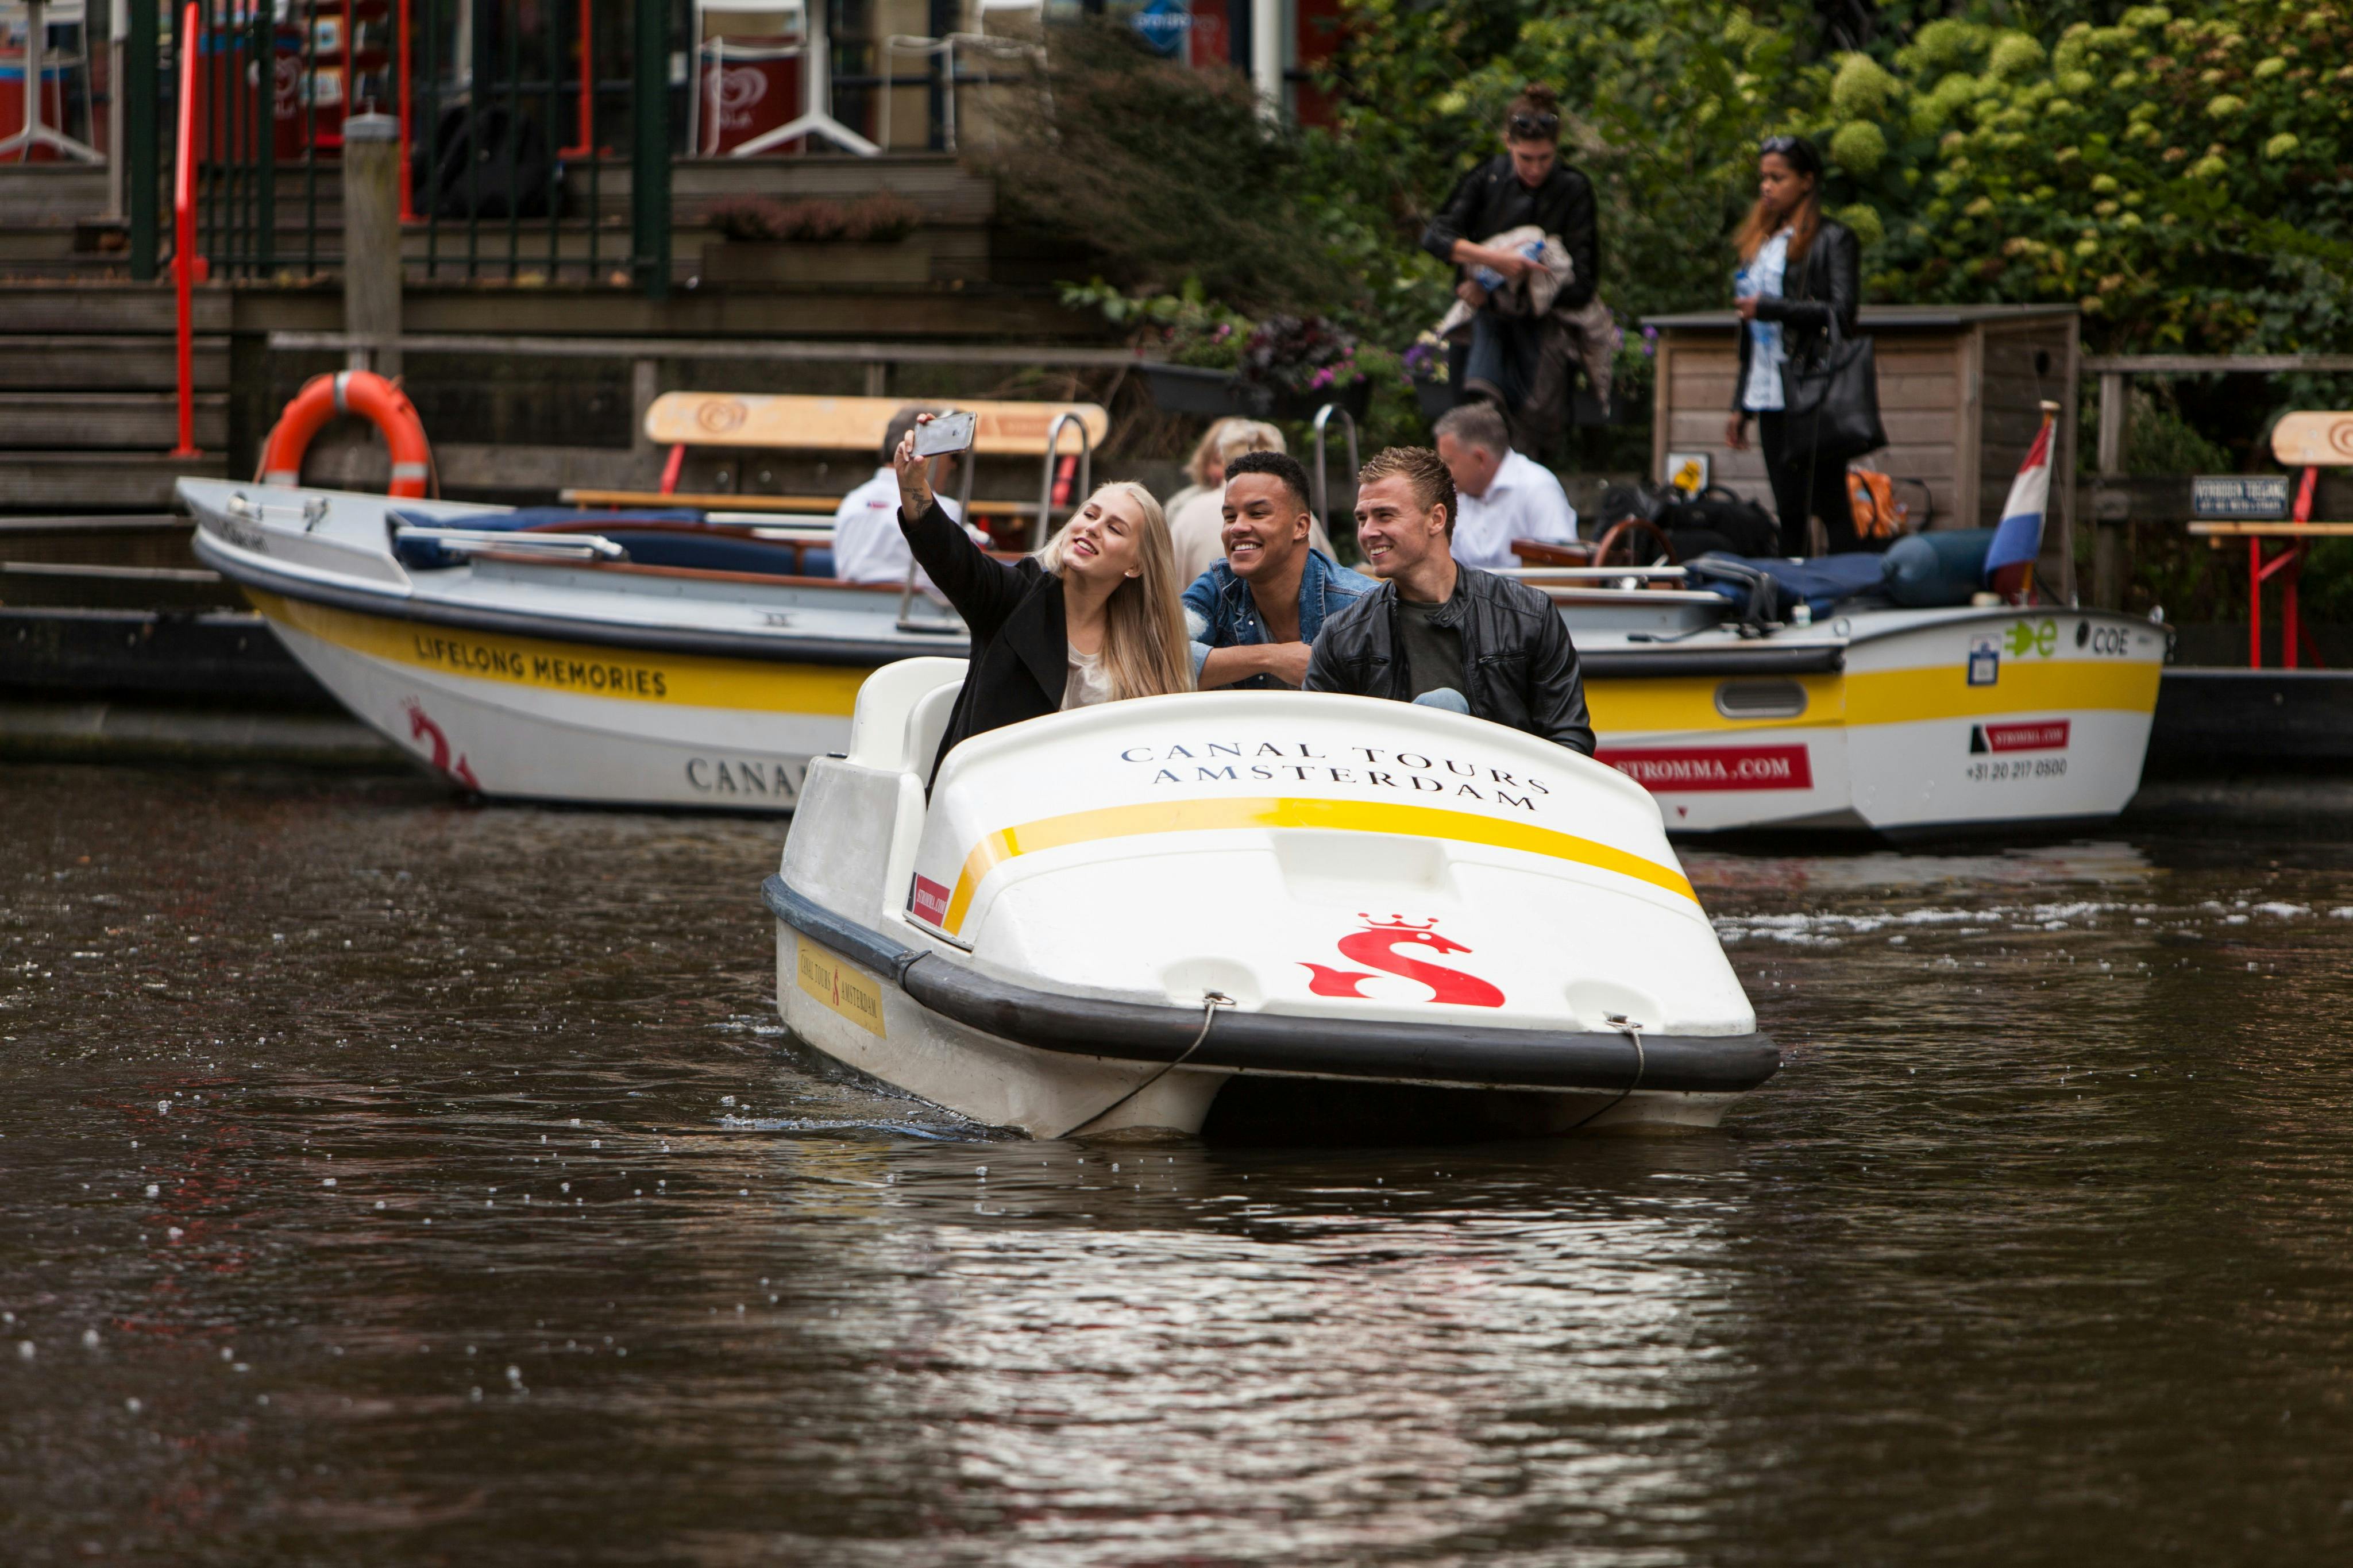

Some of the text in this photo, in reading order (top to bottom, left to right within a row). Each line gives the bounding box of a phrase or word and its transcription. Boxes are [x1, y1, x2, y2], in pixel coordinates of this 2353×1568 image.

[415, 634, 666, 697] LIFELONG MEMORIES
[1993, 728, 2063, 746] STROMMA.COM
[1122, 743, 1550, 794] CANAL TOURS
[1152, 764, 1538, 811] AMSTERDAM
[1966, 763, 1988, 782] +31
[1992, 761, 2009, 780] 20
[2012, 759, 2032, 779] 217
[917, 889, 947, 915] STROMMA.COM
[801, 954, 877, 1019] CANAL TOURS AMSTERDAM
